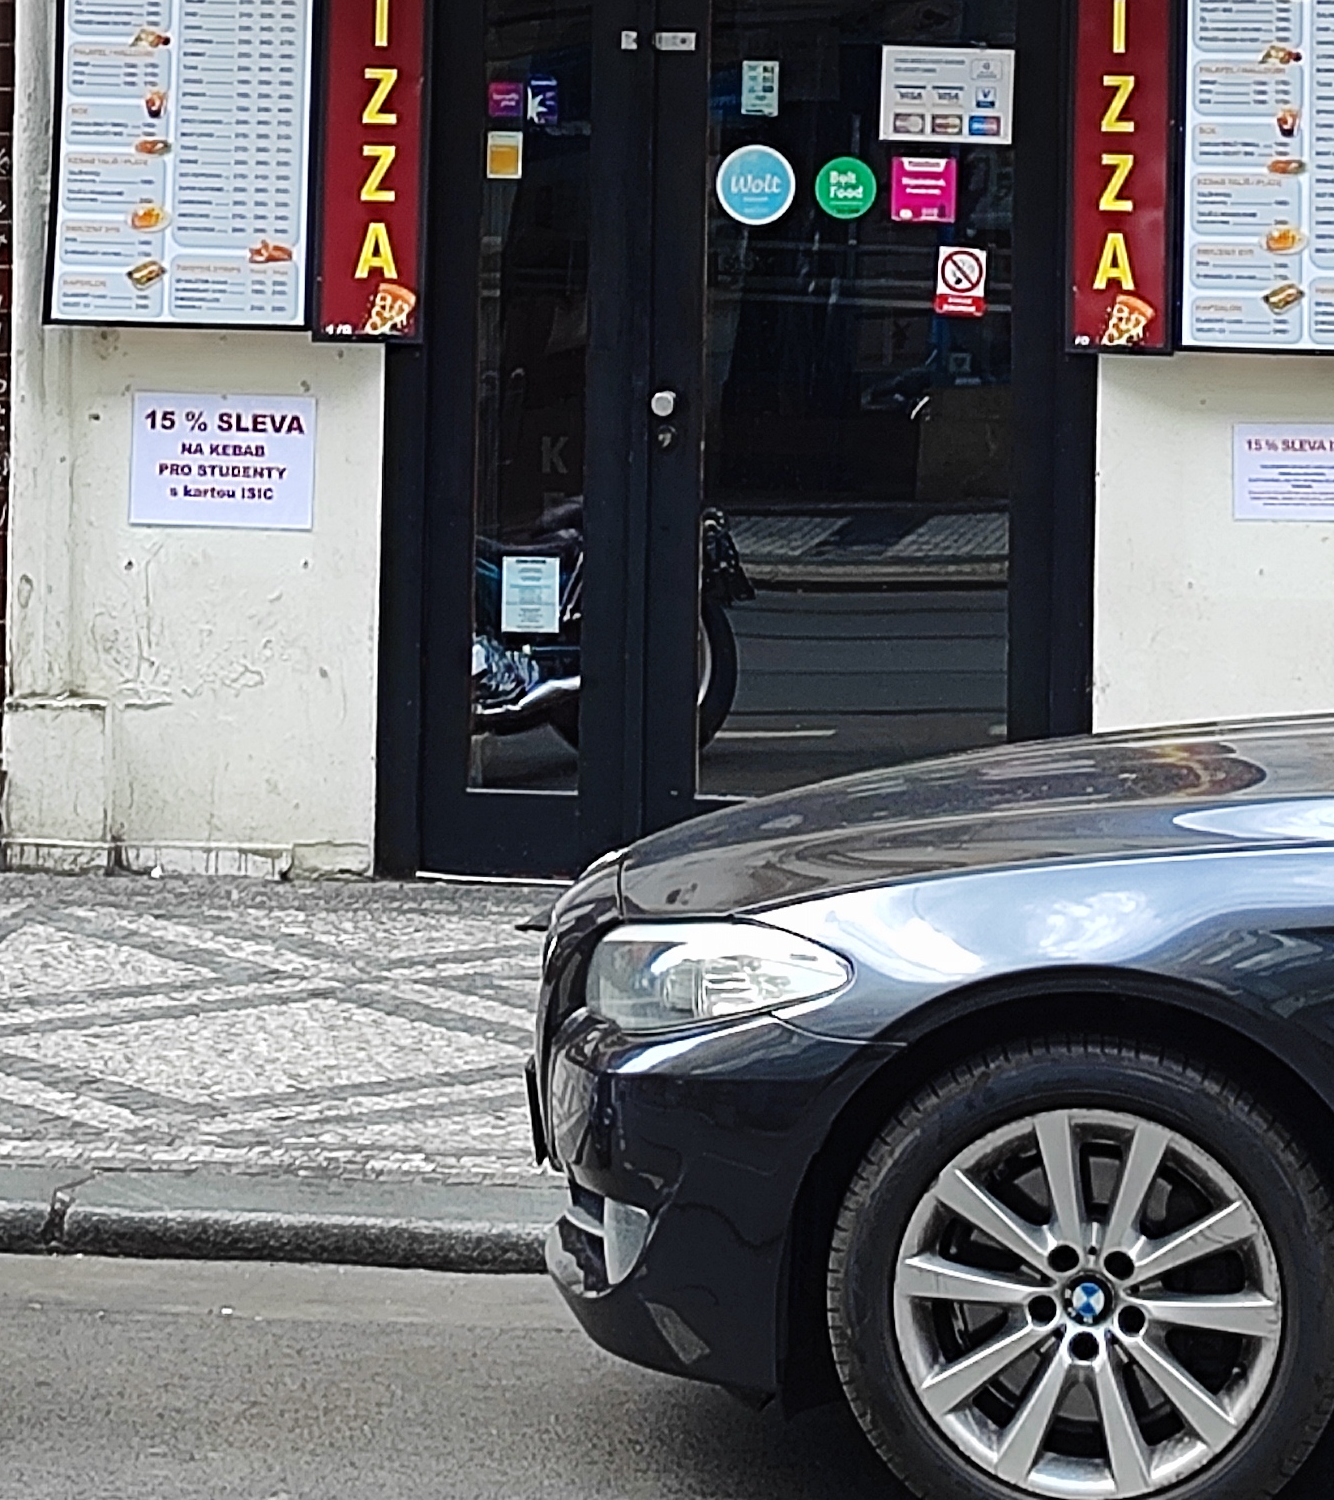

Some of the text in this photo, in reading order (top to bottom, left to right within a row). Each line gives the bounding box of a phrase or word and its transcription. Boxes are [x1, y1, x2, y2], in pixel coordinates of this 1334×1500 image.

[729, 173, 783, 195] Wolt
[828, 170, 857, 185] Bolt
[828, 185, 864, 199] Food
[144, 409, 306, 435] 15 % SLEVA
[181, 442, 266, 457] NA KEBAB
[1246, 438, 1263, 451] 15
[158, 462, 288, 479] PRO STUDENTY
[183, 485, 236, 499] kartou
[241, 487, 275, 500] ISIC
